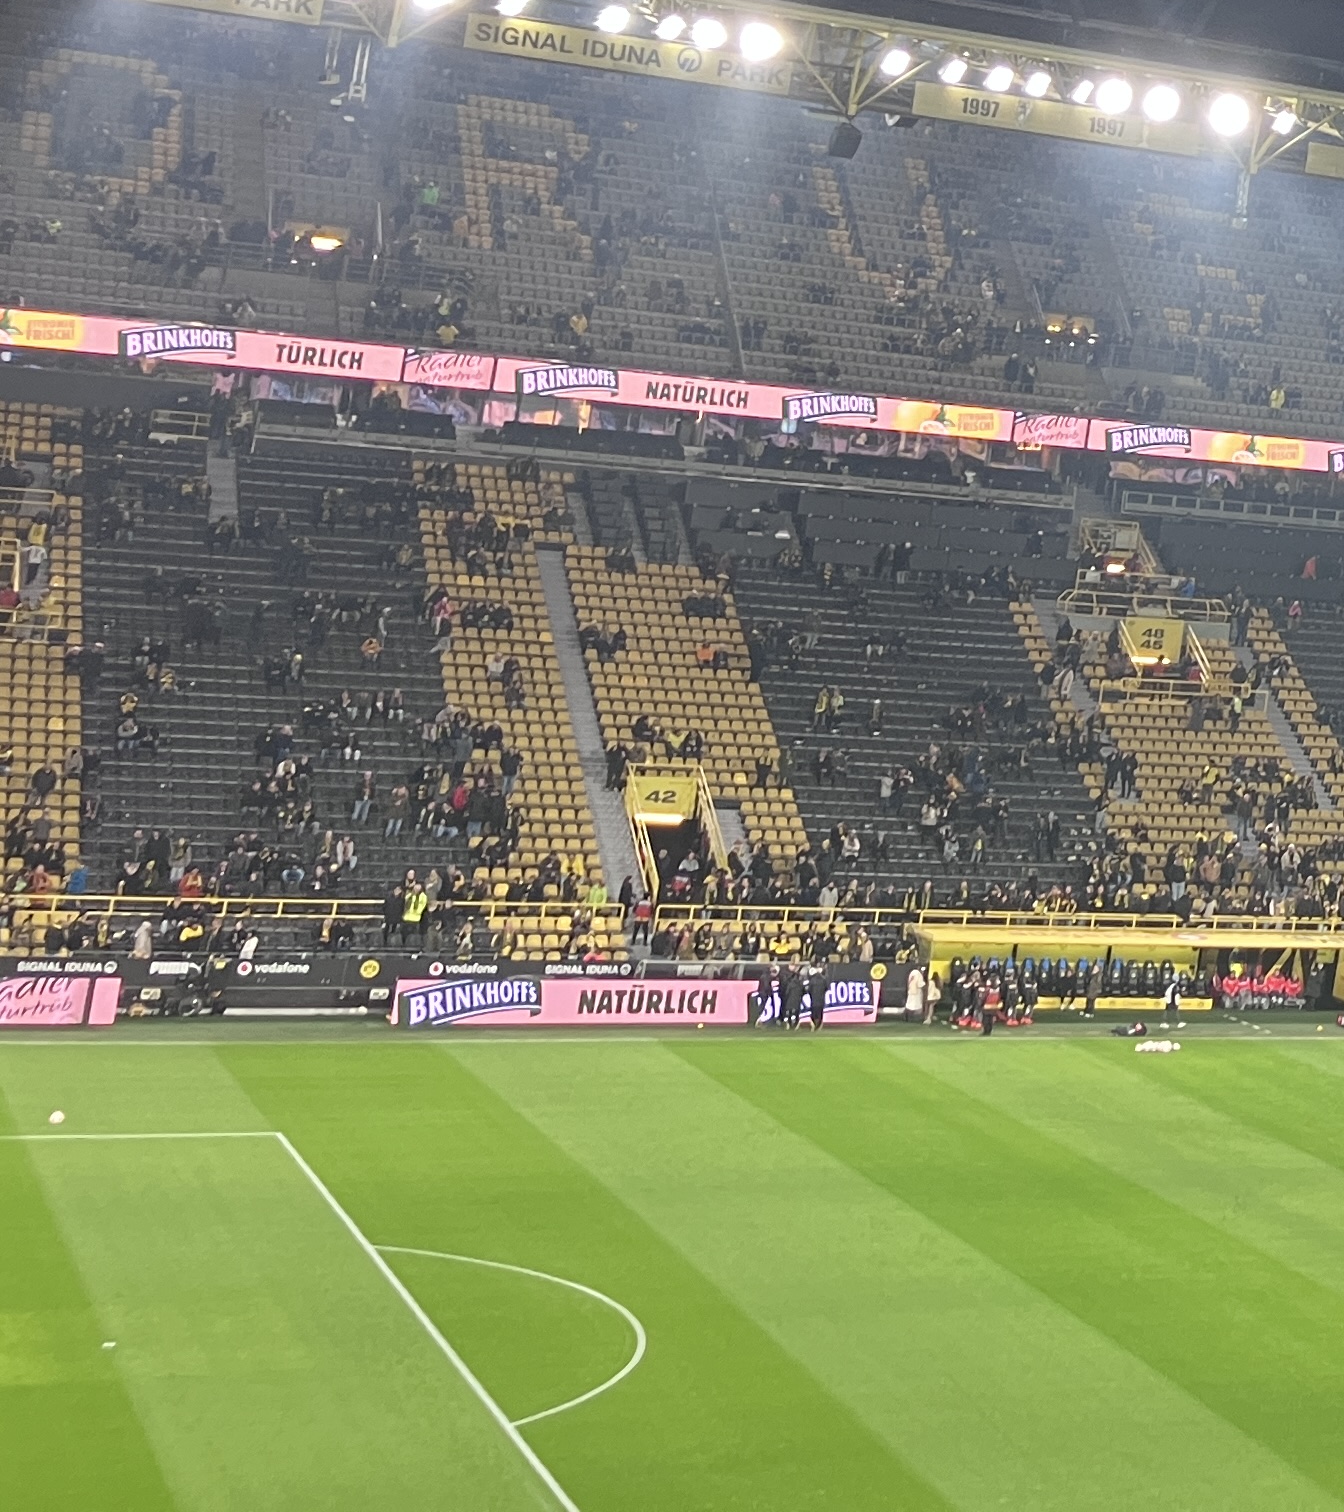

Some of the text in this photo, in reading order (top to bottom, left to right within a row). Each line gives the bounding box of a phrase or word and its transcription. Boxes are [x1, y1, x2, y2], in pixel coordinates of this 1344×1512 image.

[473, 21, 788, 87] SIGNAL IDUNA PARK
[960, 96, 1125, 138] 1997 1997
[276, 341, 364, 371] TÜRLICH
[645, 381, 749, 409] NATÜRLICH
[1141, 628, 1164, 639] 48
[1140, 639, 1163, 650] 45
[644, 790, 677, 804] 42
[17, 961, 102, 973] SIGNAL IDUNA
[254, 961, 310, 975] vodafone
[445, 963, 498, 976] vodafone
[544, 963, 619, 976] SIGNAL IDUNA
[577, 984, 717, 1014] NATÜRLICH
